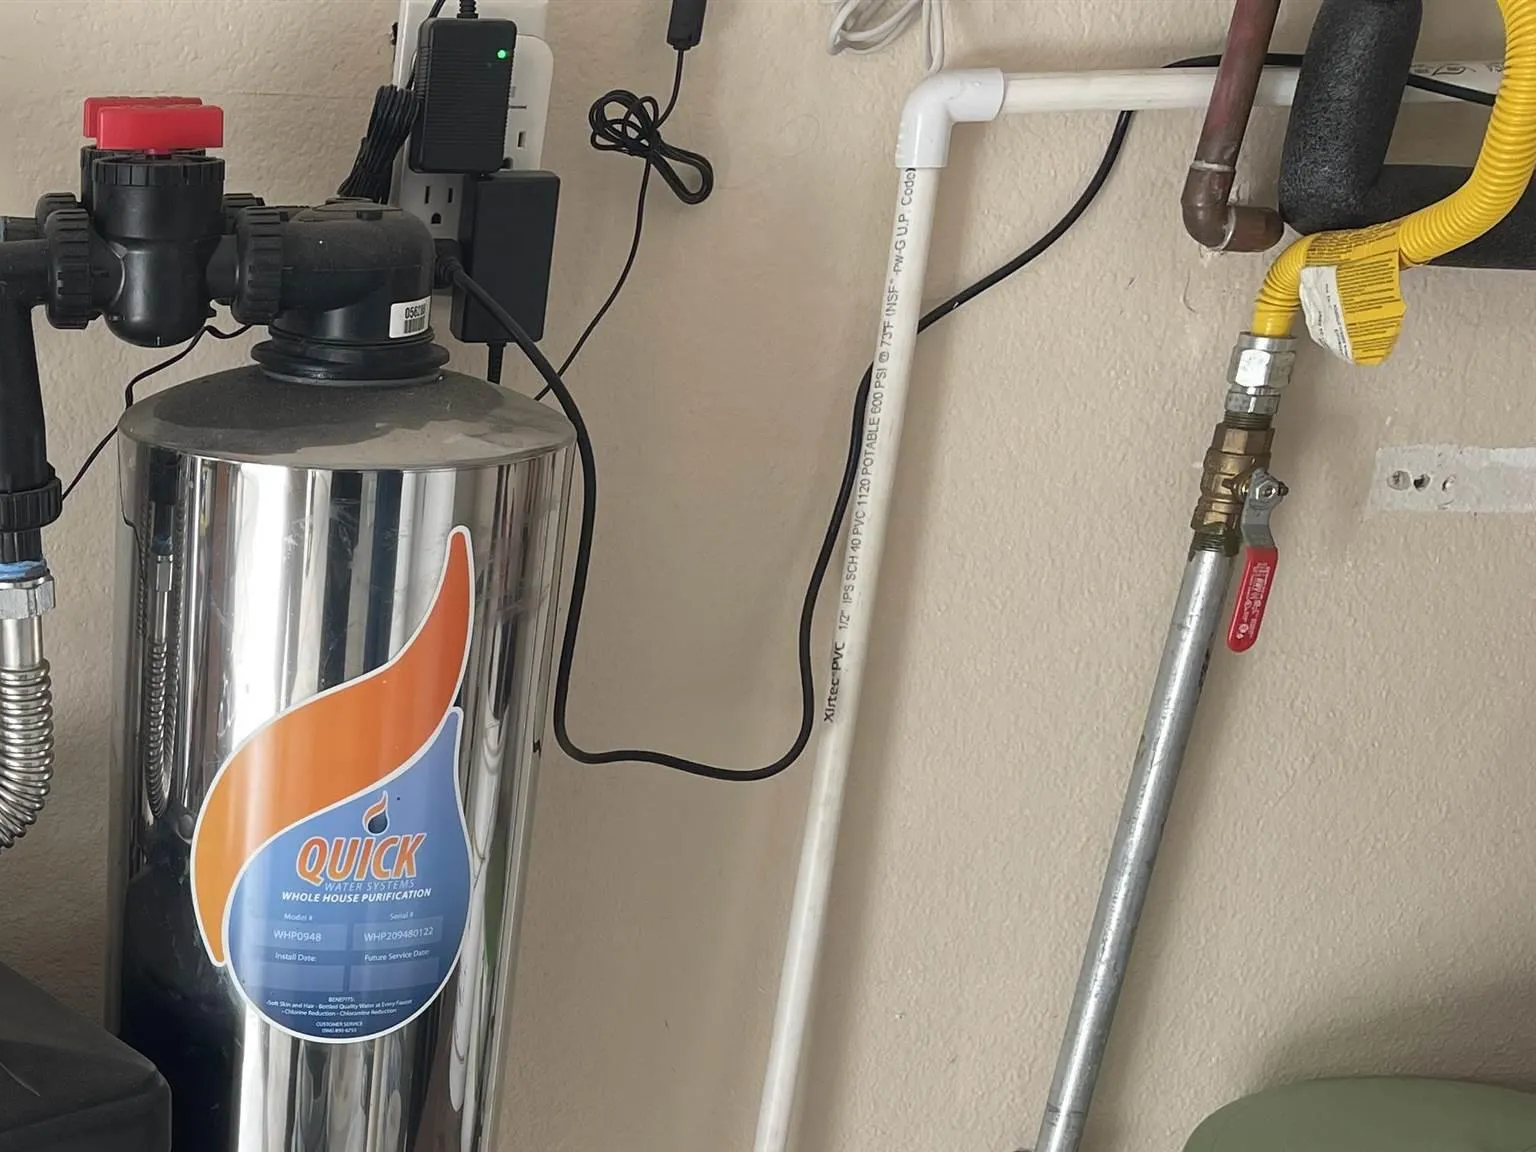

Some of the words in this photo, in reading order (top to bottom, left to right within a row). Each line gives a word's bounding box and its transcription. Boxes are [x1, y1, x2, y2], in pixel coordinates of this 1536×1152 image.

[875, 367, 888, 389] PSI
[871, 392, 883, 415] 600
[862, 417, 880, 476] POTABLE
[857, 478, 871, 505] 1120
[853, 511, 866, 537] PVC
[846, 555, 860, 581] SCH
[842, 584, 855, 604] IPS
[831, 641, 845, 671] PVC
[295, 832, 428, 886] QUICK
[325, 881, 363, 892] WATER
[366, 879, 415, 891] SYSTEMS
[282, 891, 321, 903] WHOLE
[323, 892, 359, 904] HOUSE
[361, 888, 432, 903] PURIFICATION
[283, 912, 308, 921] Model
[389, 912, 408, 920] Serial
[273, 929, 322, 942] WHP0948
[364, 926, 434, 942] WHP209480122
[275, 951, 297, 961] Install
[364, 953, 387, 961] Future
[388, 951, 412, 961] Service
